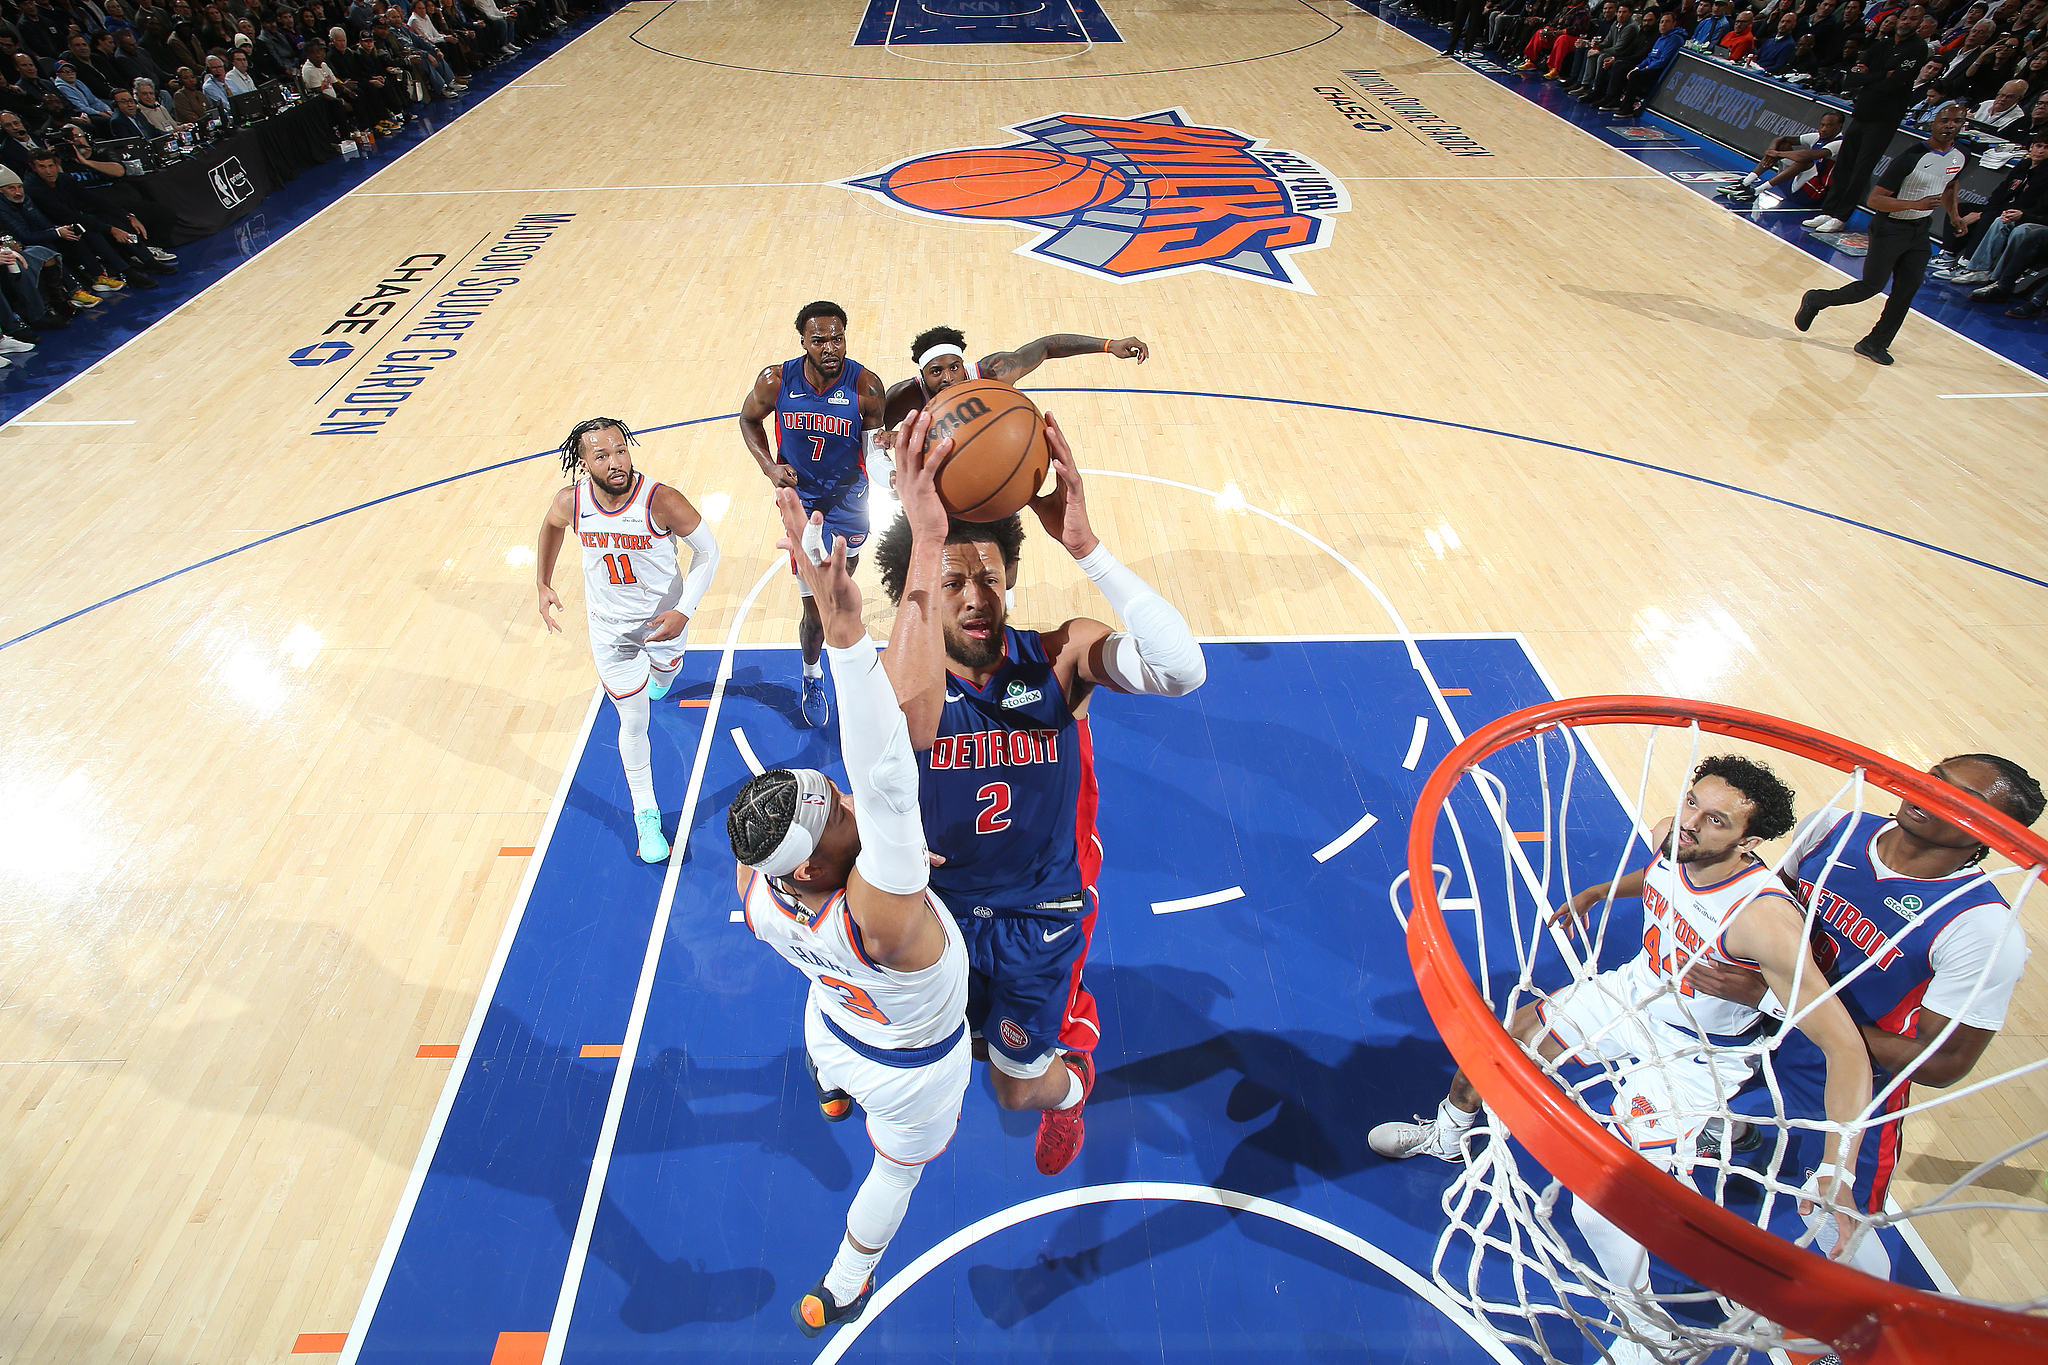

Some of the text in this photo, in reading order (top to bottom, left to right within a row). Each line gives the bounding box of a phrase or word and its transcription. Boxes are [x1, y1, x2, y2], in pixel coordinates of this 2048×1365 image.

[1313, 86, 1377, 120] CHASE
[1340, 69, 1495, 157] MADISON SQUARE GARDEN
[1675, 73, 1719, 111] GOOD
[1705, 84, 1765, 130] SPORTS
[1755, 109, 1780, 131] WITH
[1058, 113, 1313, 275] KNICKS
[1248, 149, 1338, 212] NEW YORK
[321, 253, 447, 336] CHASE
[310, 213, 577, 436] MADISON SQUARE GARDEN
[782, 412, 852, 437] DETROIT
[807, 435, 826, 461] 7
[579, 532, 653, 550] NEW YORK
[602, 553, 638, 585] 11
[929, 728, 1060, 771] DETROIT
[975, 781, 1013, 835] 2
[1643, 880, 1669, 921] NEW
[1798, 877, 1905, 972] DETROIT
[1811, 930, 1840, 975] 9
[817, 974, 892, 1026] 3
